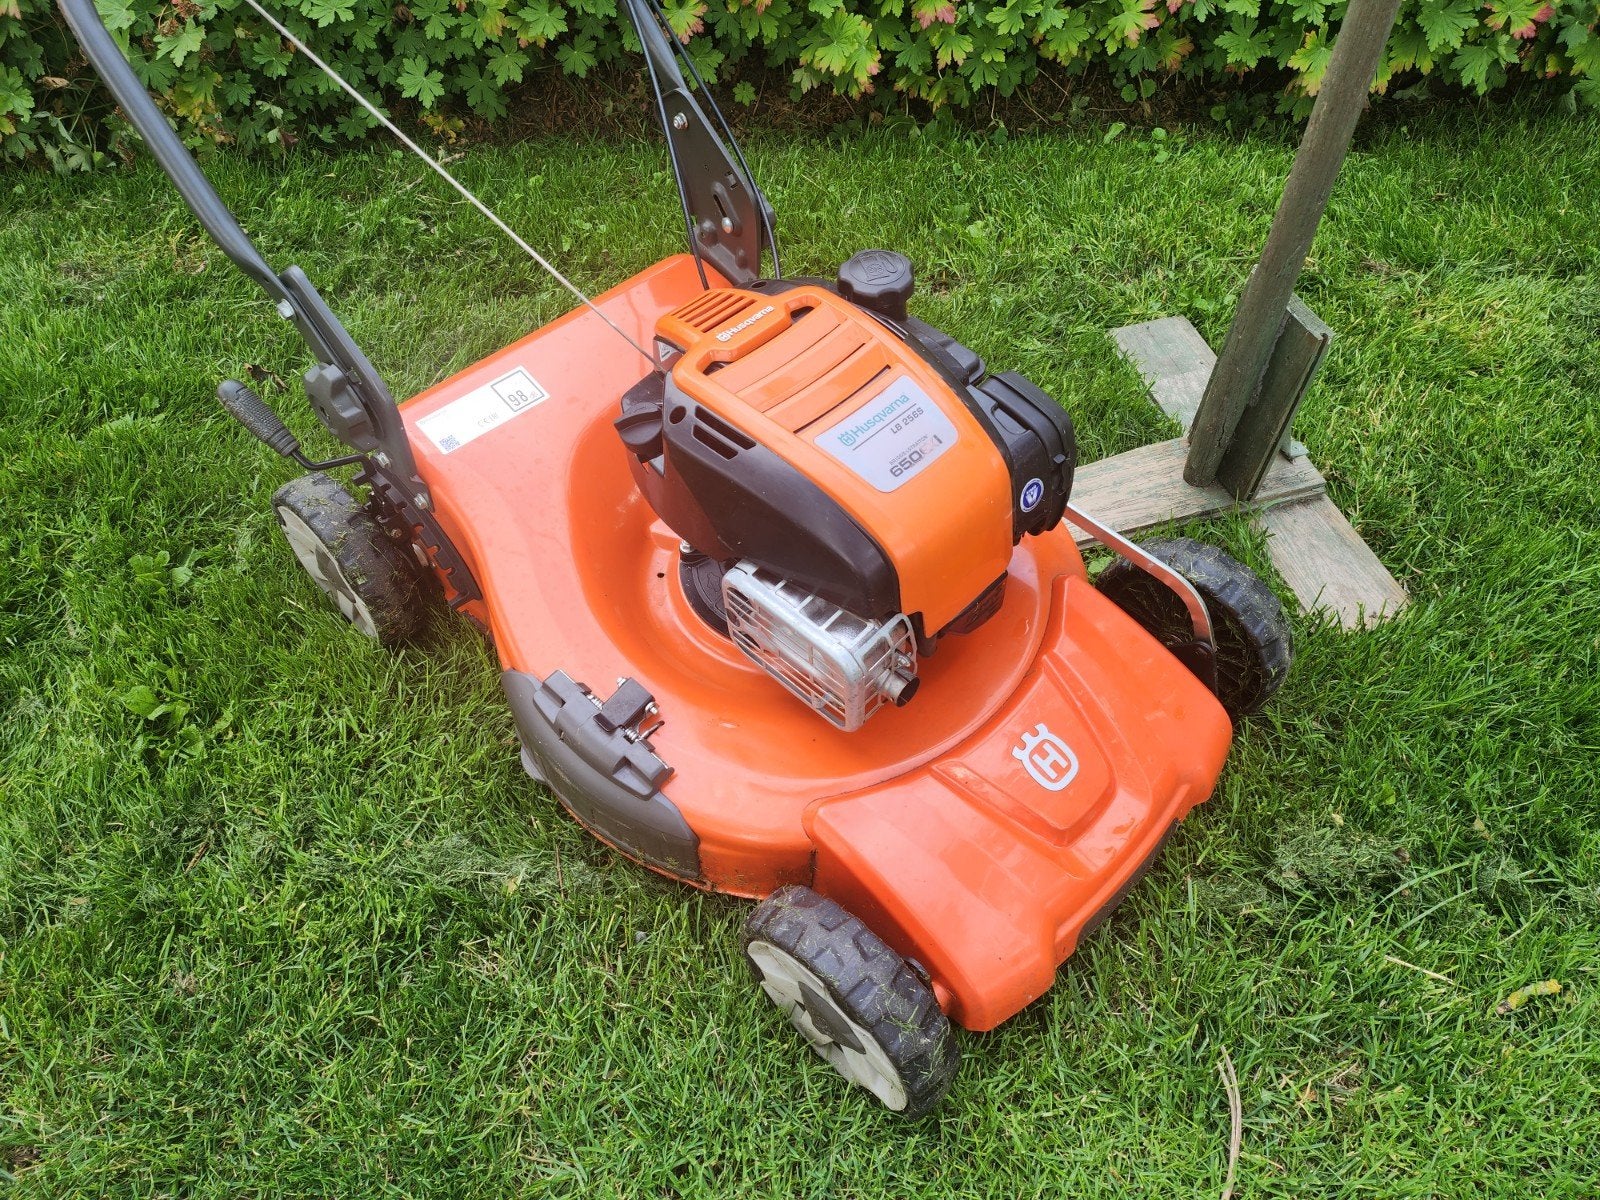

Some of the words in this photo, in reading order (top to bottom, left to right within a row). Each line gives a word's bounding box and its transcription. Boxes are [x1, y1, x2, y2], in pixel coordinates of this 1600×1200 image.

[725, 305, 775, 336] Husqvarna
[507, 389, 529, 407] 98
[850, 393, 910, 438] Husqvarna
[890, 422, 903, 435] LB
[902, 407, 924, 427] 256S
